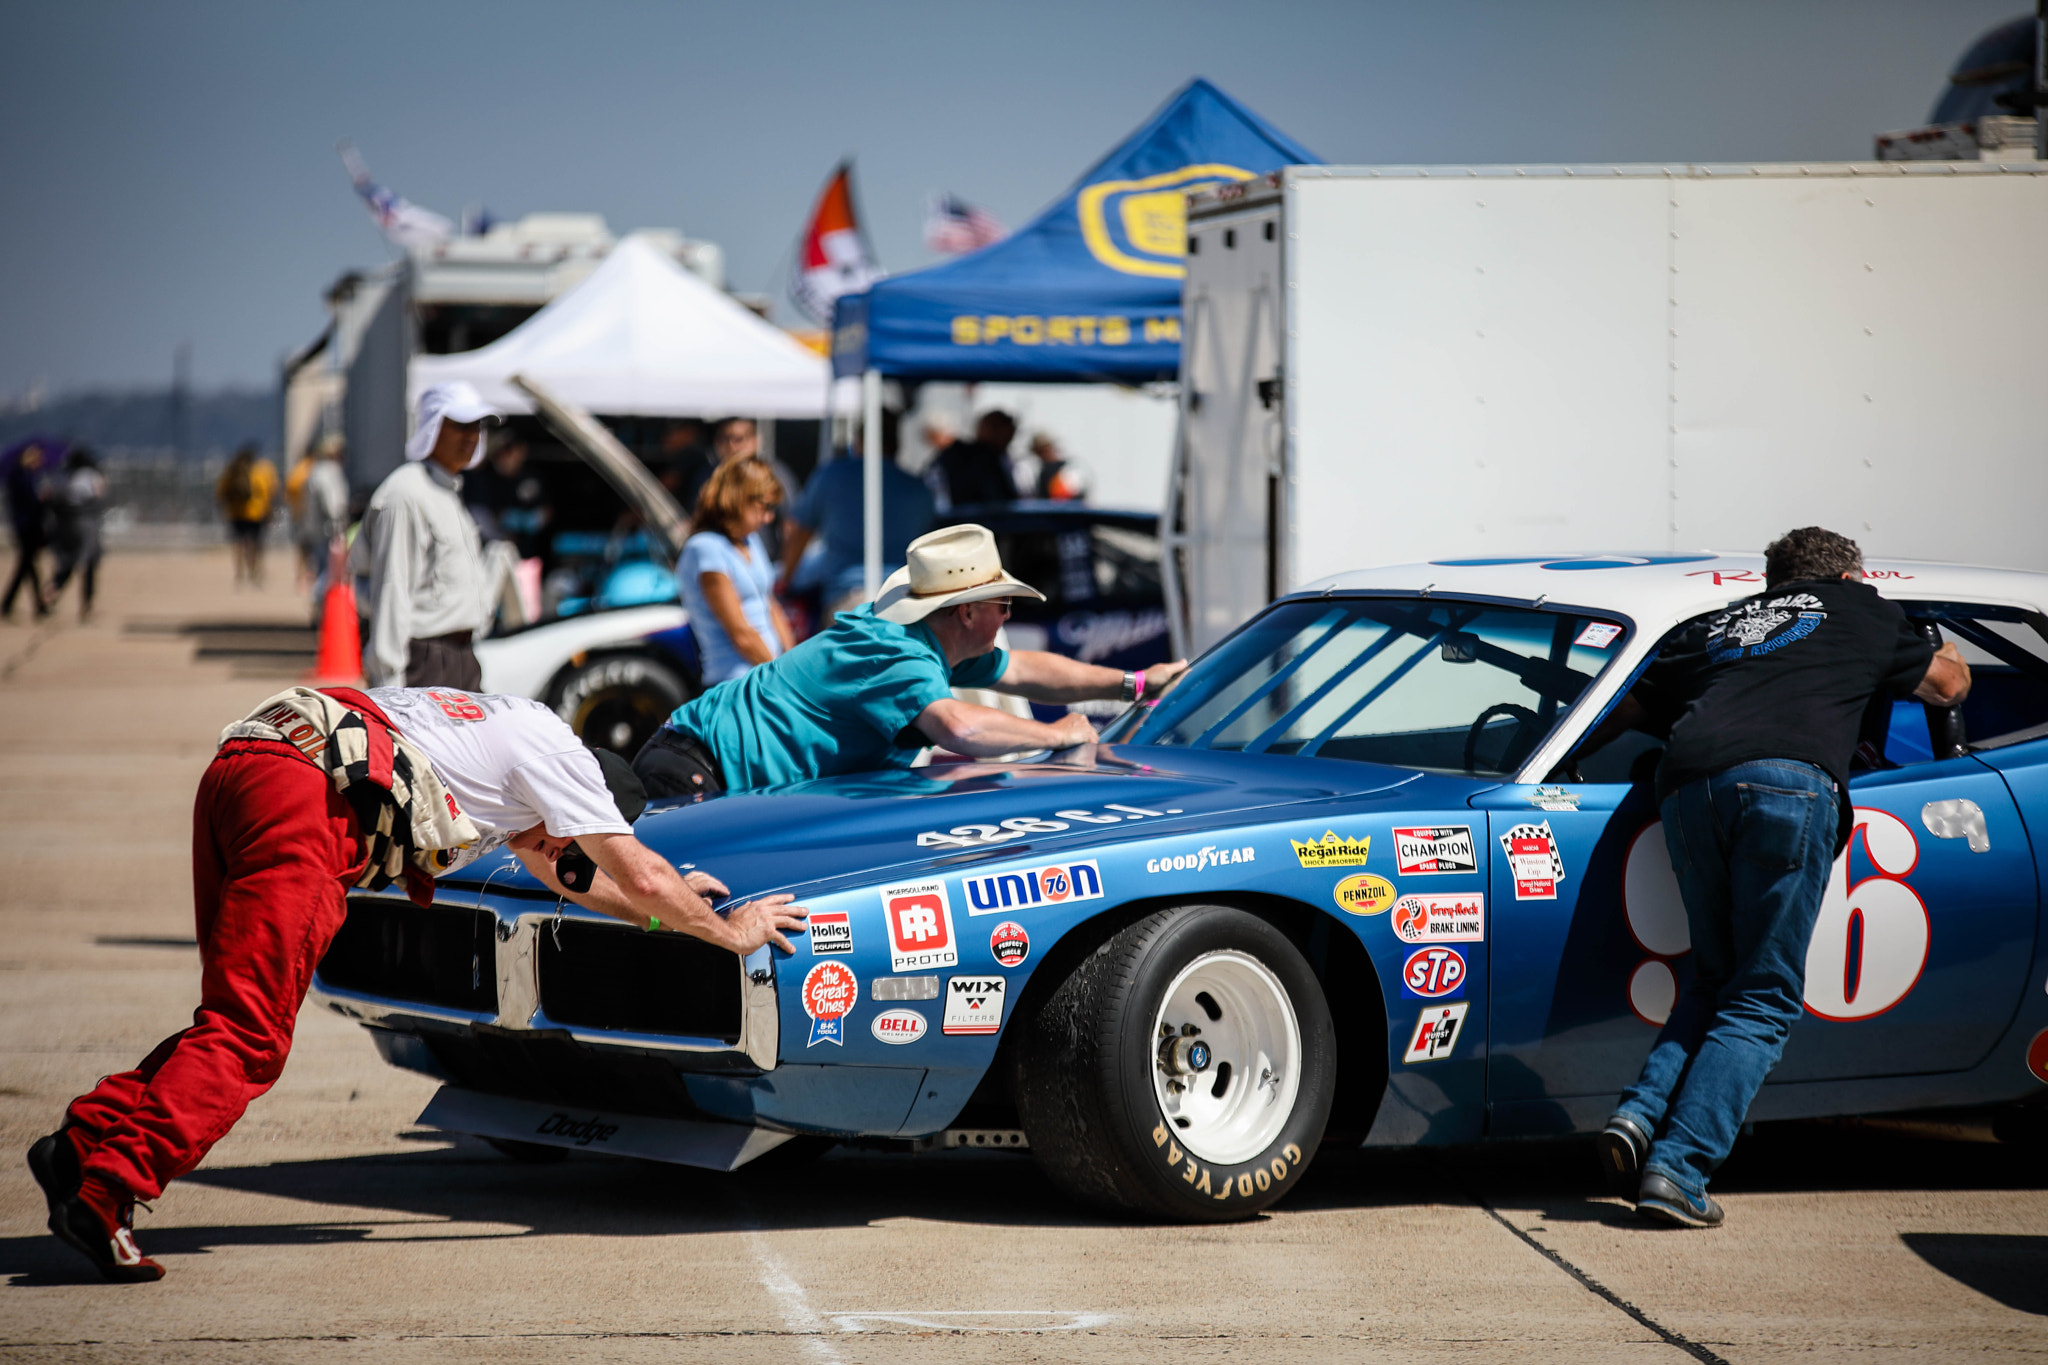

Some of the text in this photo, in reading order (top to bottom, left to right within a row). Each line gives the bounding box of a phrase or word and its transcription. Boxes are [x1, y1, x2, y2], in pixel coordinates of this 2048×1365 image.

[951, 315, 1132, 346] SPORTS
[916, 817, 1070, 848] 426
[1402, 843, 1470, 857] CHAMPION
[1146, 845, 1256, 873] GOODYEAR
[1419, 862, 1437, 870] SPARK
[887, 885, 939, 895] INGERSOLL-RAND
[1045, 874, 1067, 896] 76
[1343, 886, 1387, 902] PENNZOIL
[811, 925, 849, 939] Holley
[1431, 922, 1479, 933] BRAKE LINING
[998, 941, 1023, 949] PERFECT
[895, 953, 955, 967] PROTO
[1001, 949, 1021, 957] CIRCLE
[821, 968, 839, 985] the
[1409, 951, 1461, 991] STP
[811, 981, 849, 1000] Great
[951, 981, 1003, 993] WIX
[816, 998, 845, 1014] Ones
[880, 1018, 919, 1032] BELL
[1424, 1030, 1449, 1040] HURST
[536, 1112, 619, 1147] Dodge
[1152, 1119, 1302, 1200] GOODYEAR
